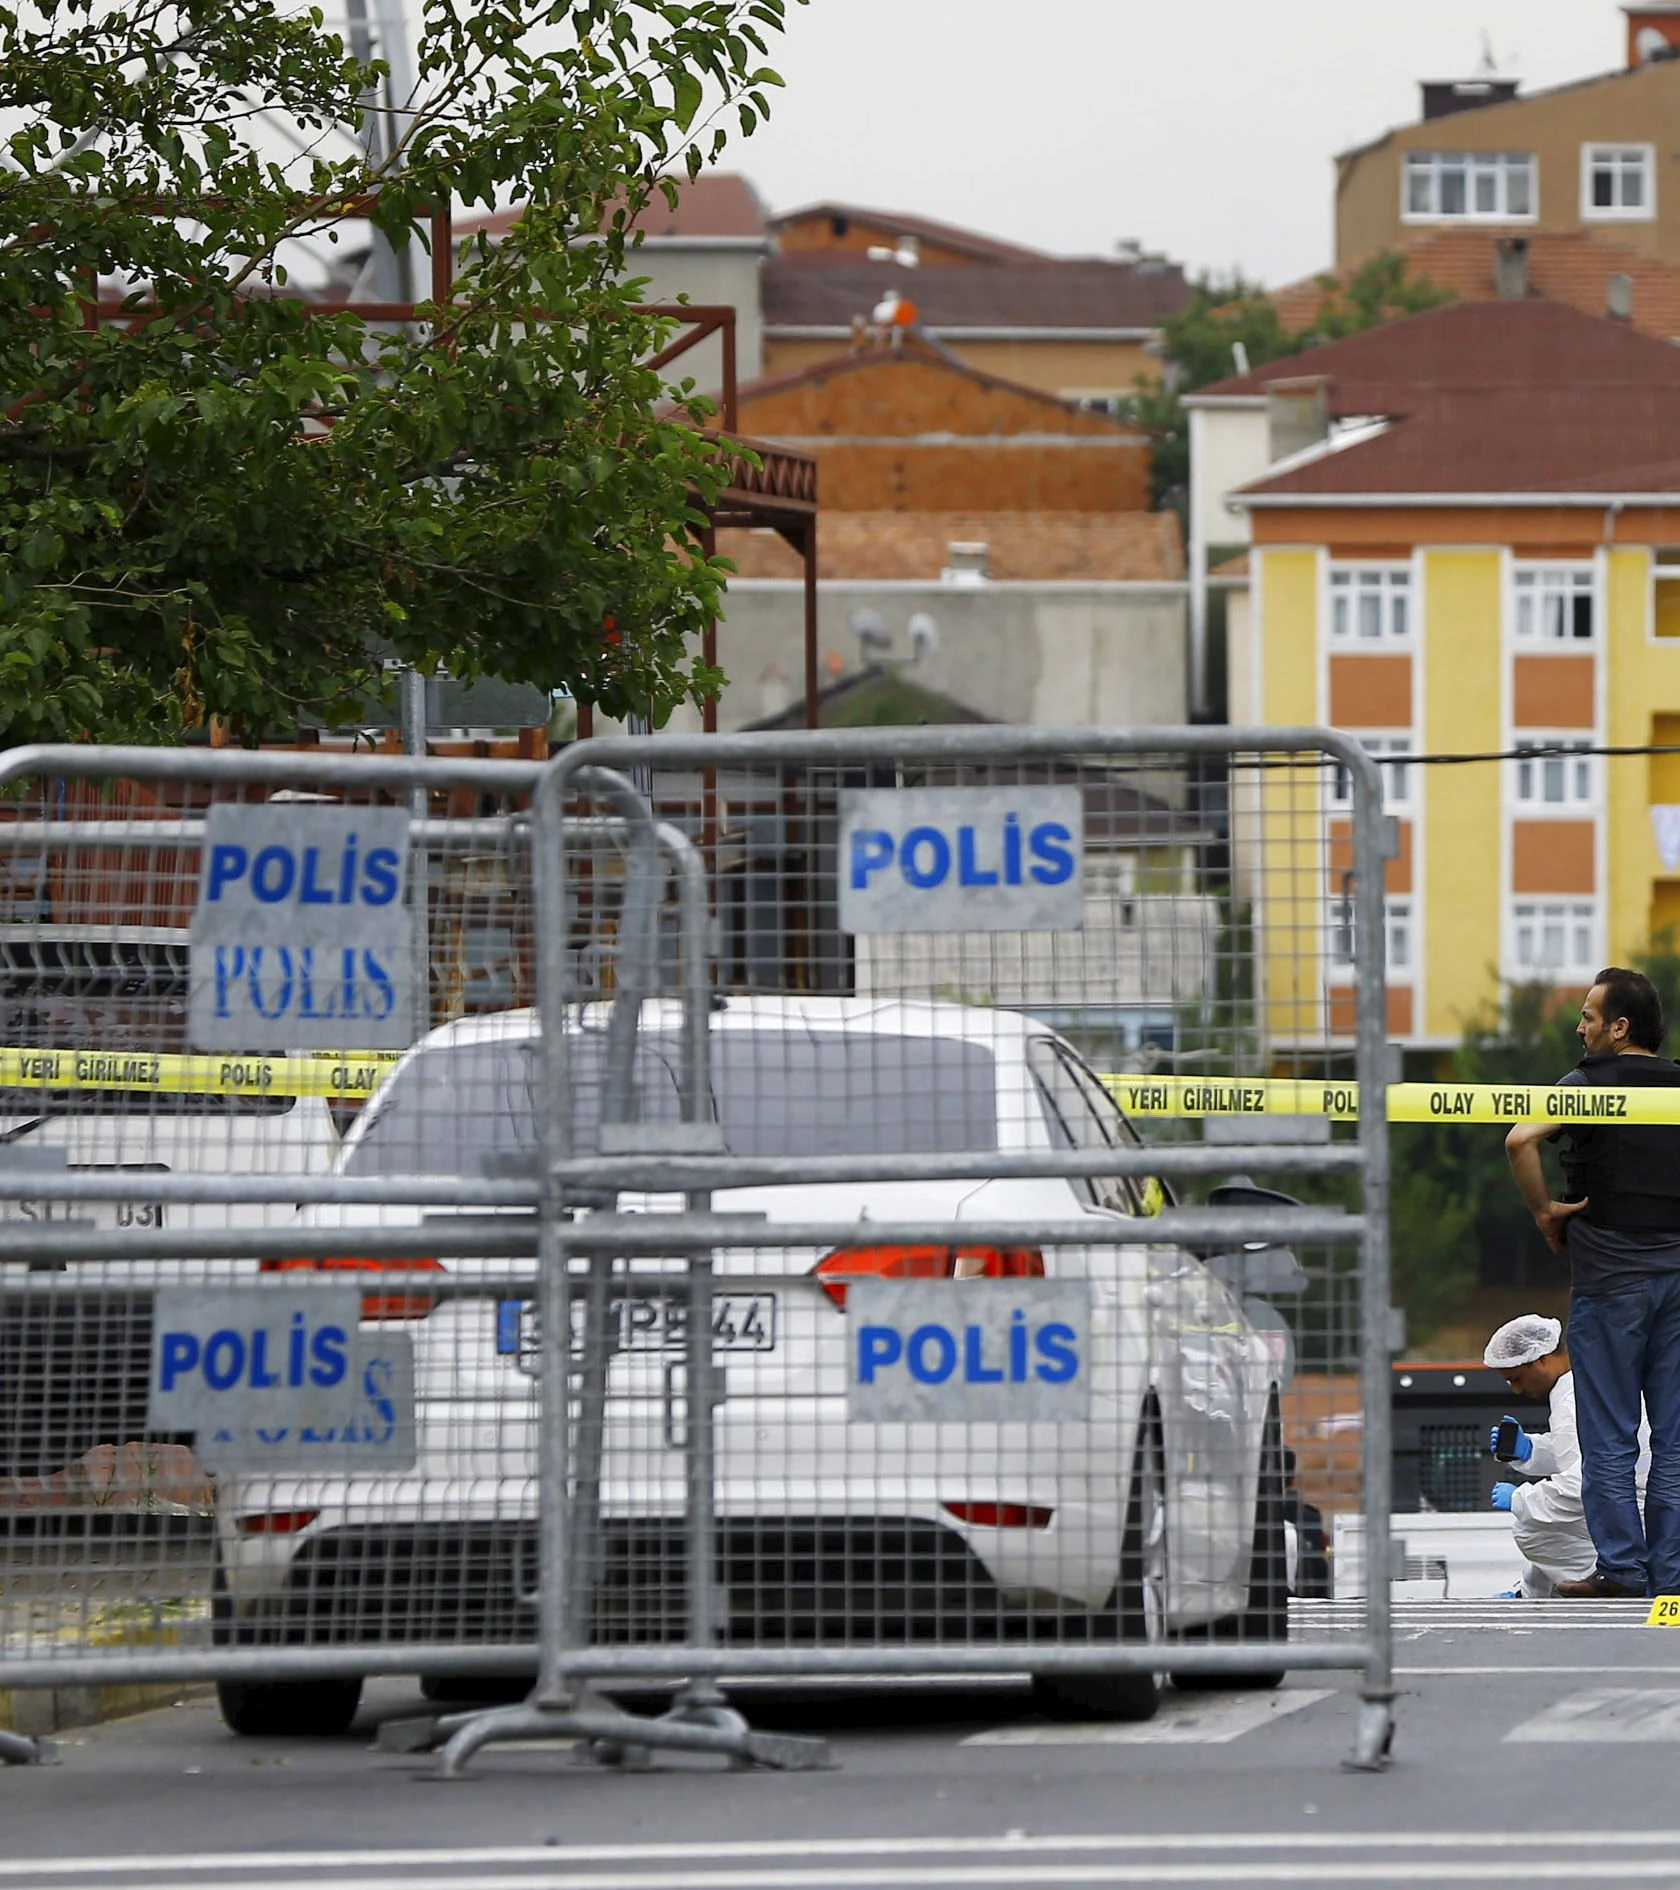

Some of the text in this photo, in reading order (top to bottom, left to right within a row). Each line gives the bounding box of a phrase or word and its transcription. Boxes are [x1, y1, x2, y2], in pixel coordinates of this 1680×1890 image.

[206, 833, 400, 906] POLİS
[851, 811, 1075, 889] POLİS
[20, 1055, 377, 1090] YERİ GİRİLMEZ POLİS OLAY
[1129, 1083, 1357, 1113] YERİ GİRİLMEZ POL
[1430, 1092, 1475, 1115] OLAY
[1491, 1089, 1531, 1116] YERİ
[1546, 1090, 1627, 1117] GİRİLMEZ
[159, 1311, 348, 1393] POLİS
[857, 1308, 1079, 1386] POLİS
[1659, 1601, 1678, 1616] 26
